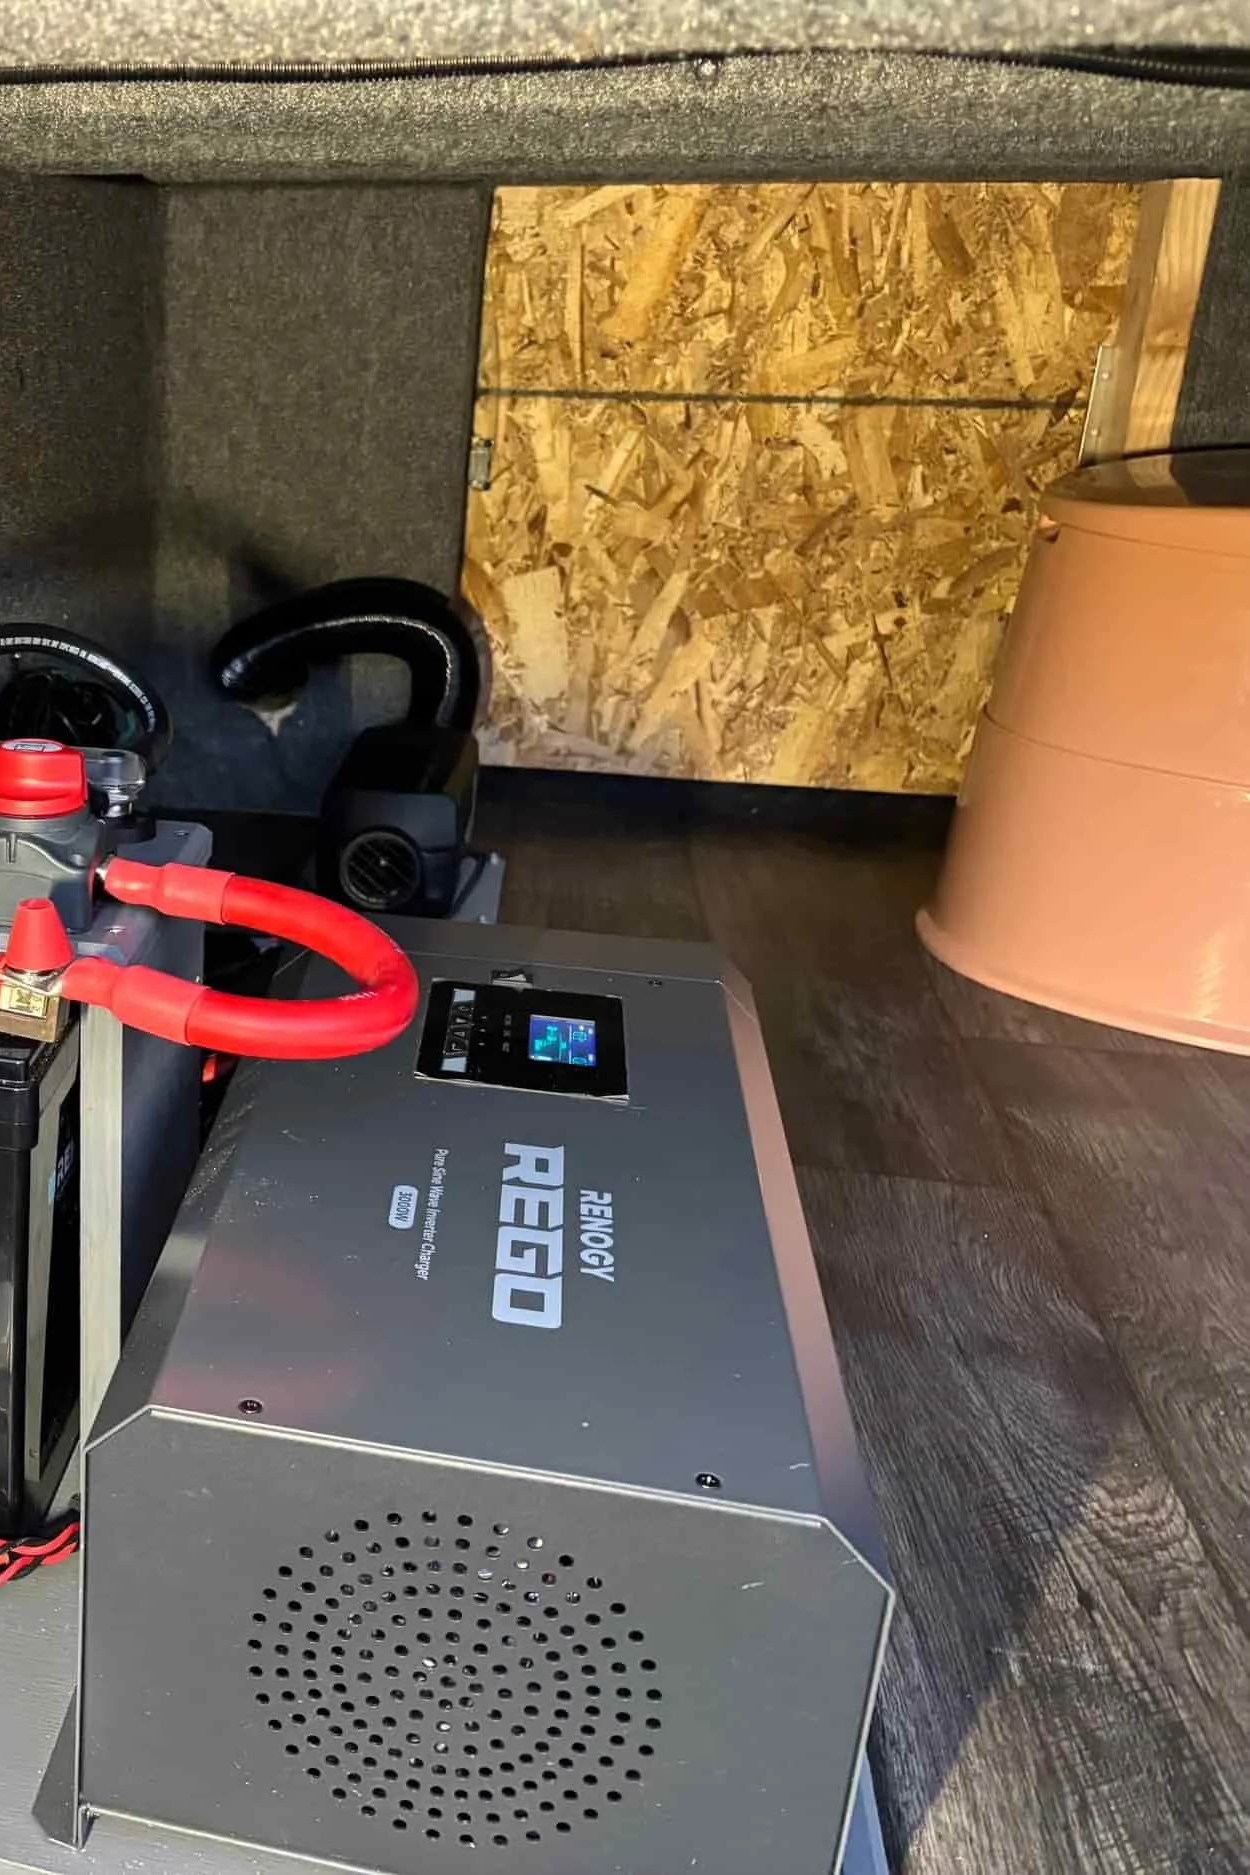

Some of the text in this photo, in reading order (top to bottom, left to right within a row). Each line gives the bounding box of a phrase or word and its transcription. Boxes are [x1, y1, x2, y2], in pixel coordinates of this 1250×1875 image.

[396, 1190, 411, 1226] 3000W
[414, 1148, 449, 1280] Pure Sine Wave Inverter Charger
[491, 1142, 565, 1330] REGO
[579, 1188, 614, 1283] RENOGY
